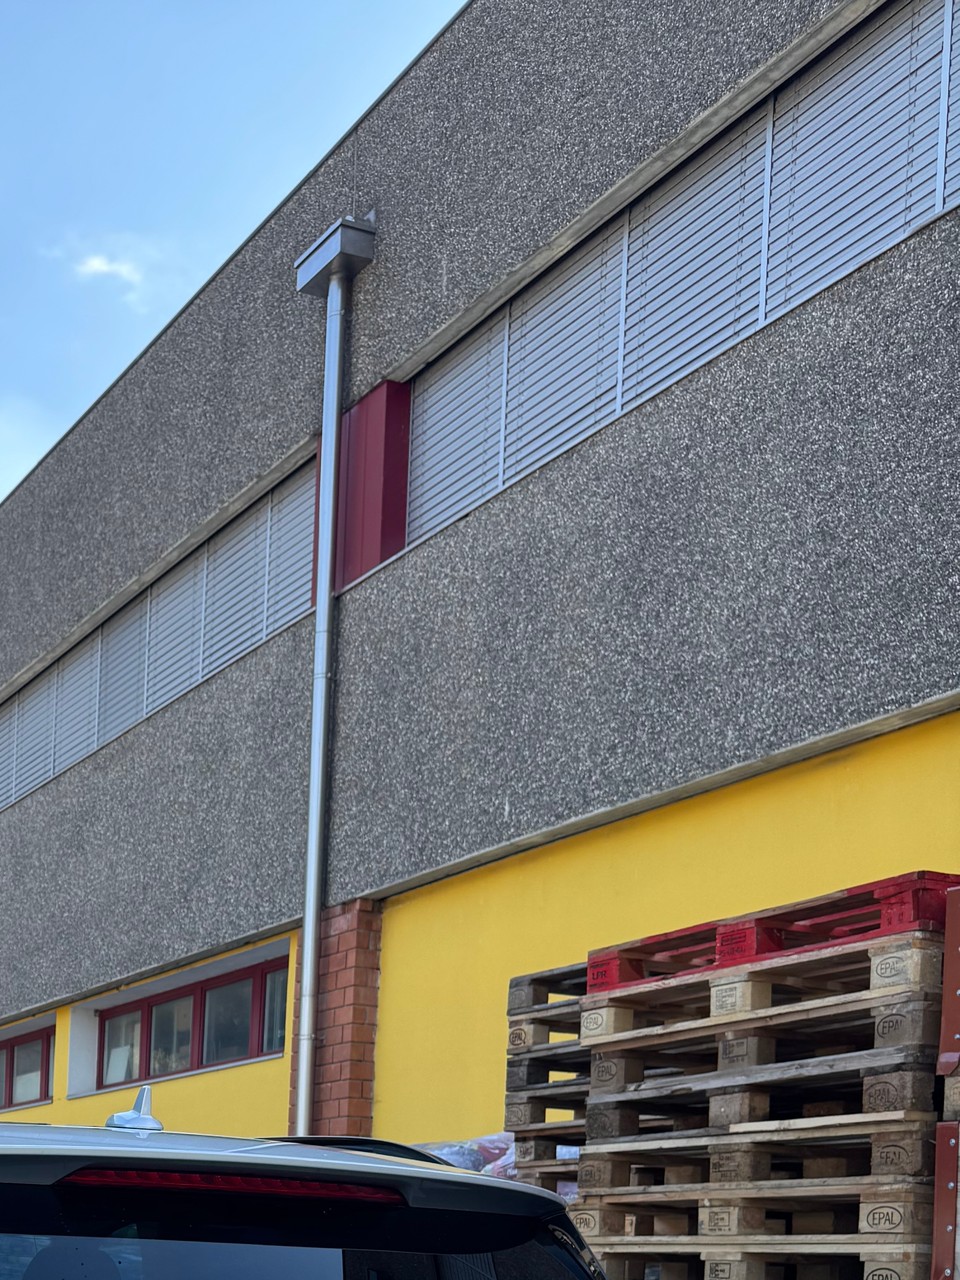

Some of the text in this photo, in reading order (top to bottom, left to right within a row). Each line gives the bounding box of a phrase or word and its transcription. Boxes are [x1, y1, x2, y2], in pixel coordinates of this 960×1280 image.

[880, 961, 900, 975] EPA
[597, 1066, 614, 1079] EPAL
[574, 1217, 591, 1229] EPAL
[872, 1211, 897, 1226] EPAL
